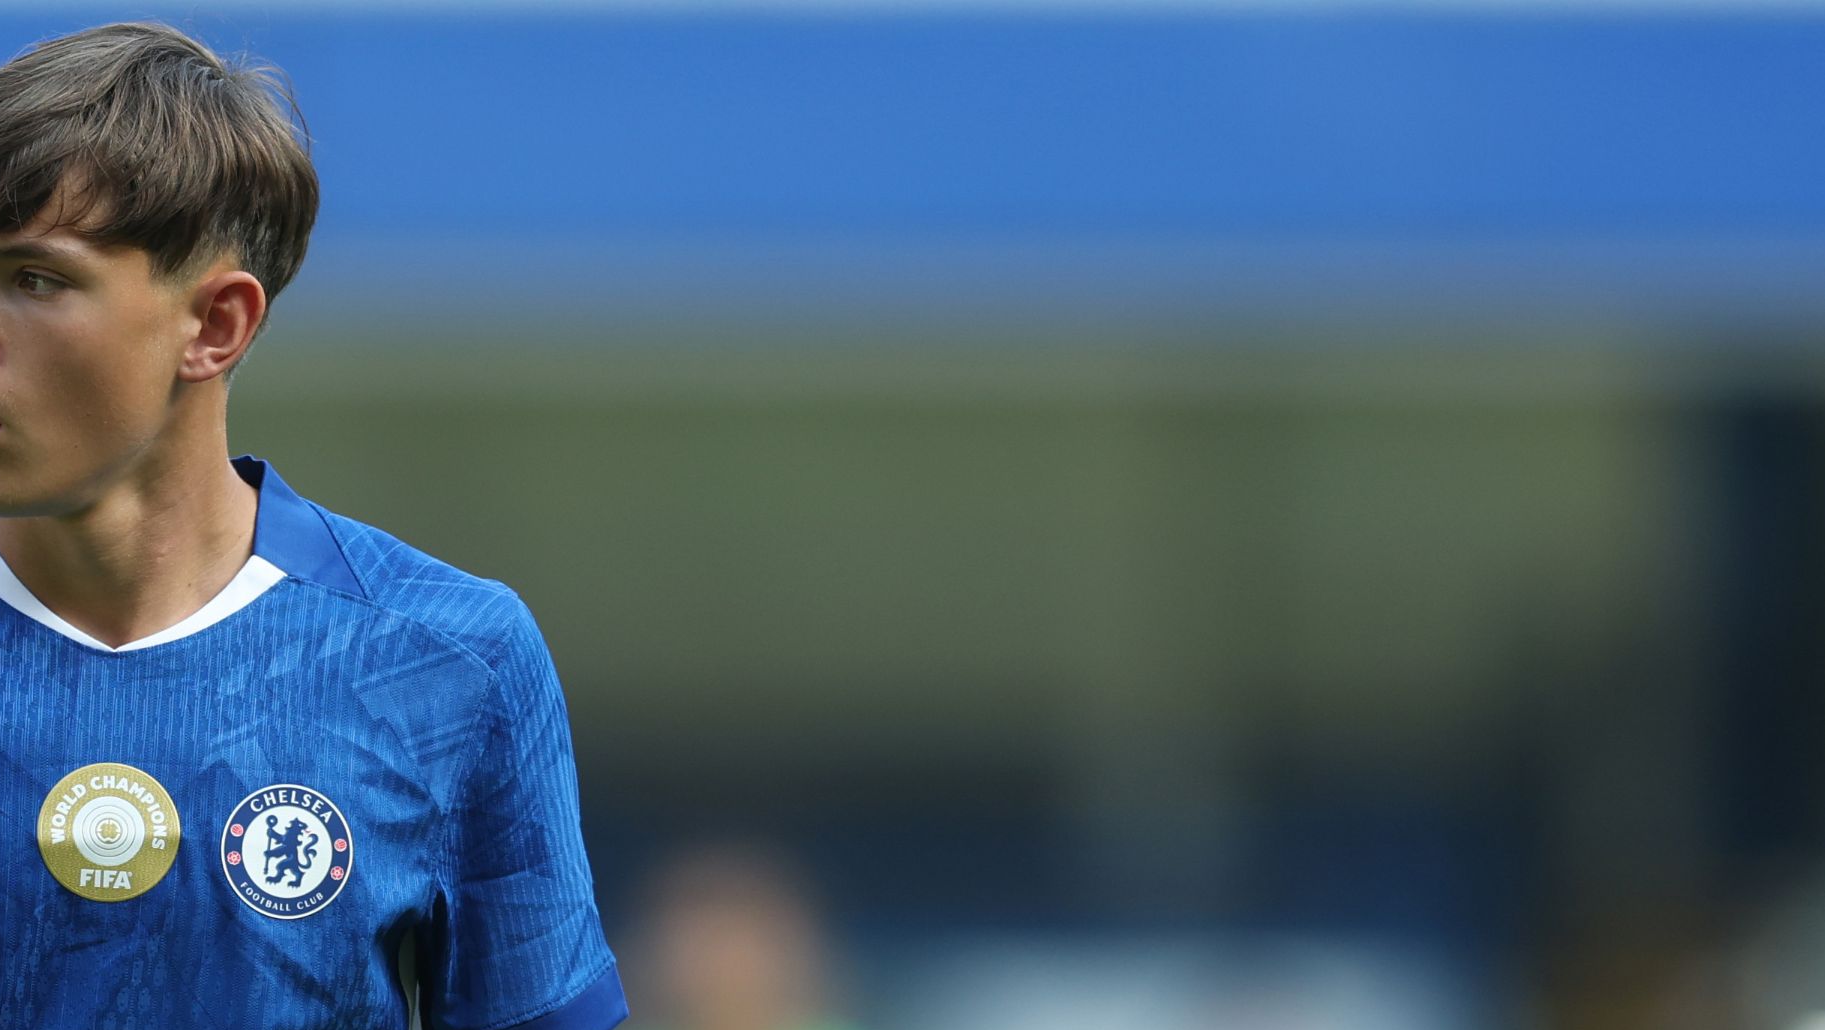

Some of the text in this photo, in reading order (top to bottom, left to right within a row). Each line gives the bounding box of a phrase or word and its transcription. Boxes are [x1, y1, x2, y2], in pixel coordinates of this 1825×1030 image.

[50, 775, 167, 850] WORLD CHAMPIONS
[250, 790, 333, 823] CHELSEA
[79, 868, 132, 889] FIFA
[240, 881, 324, 911] FOOTBALL CLUB
